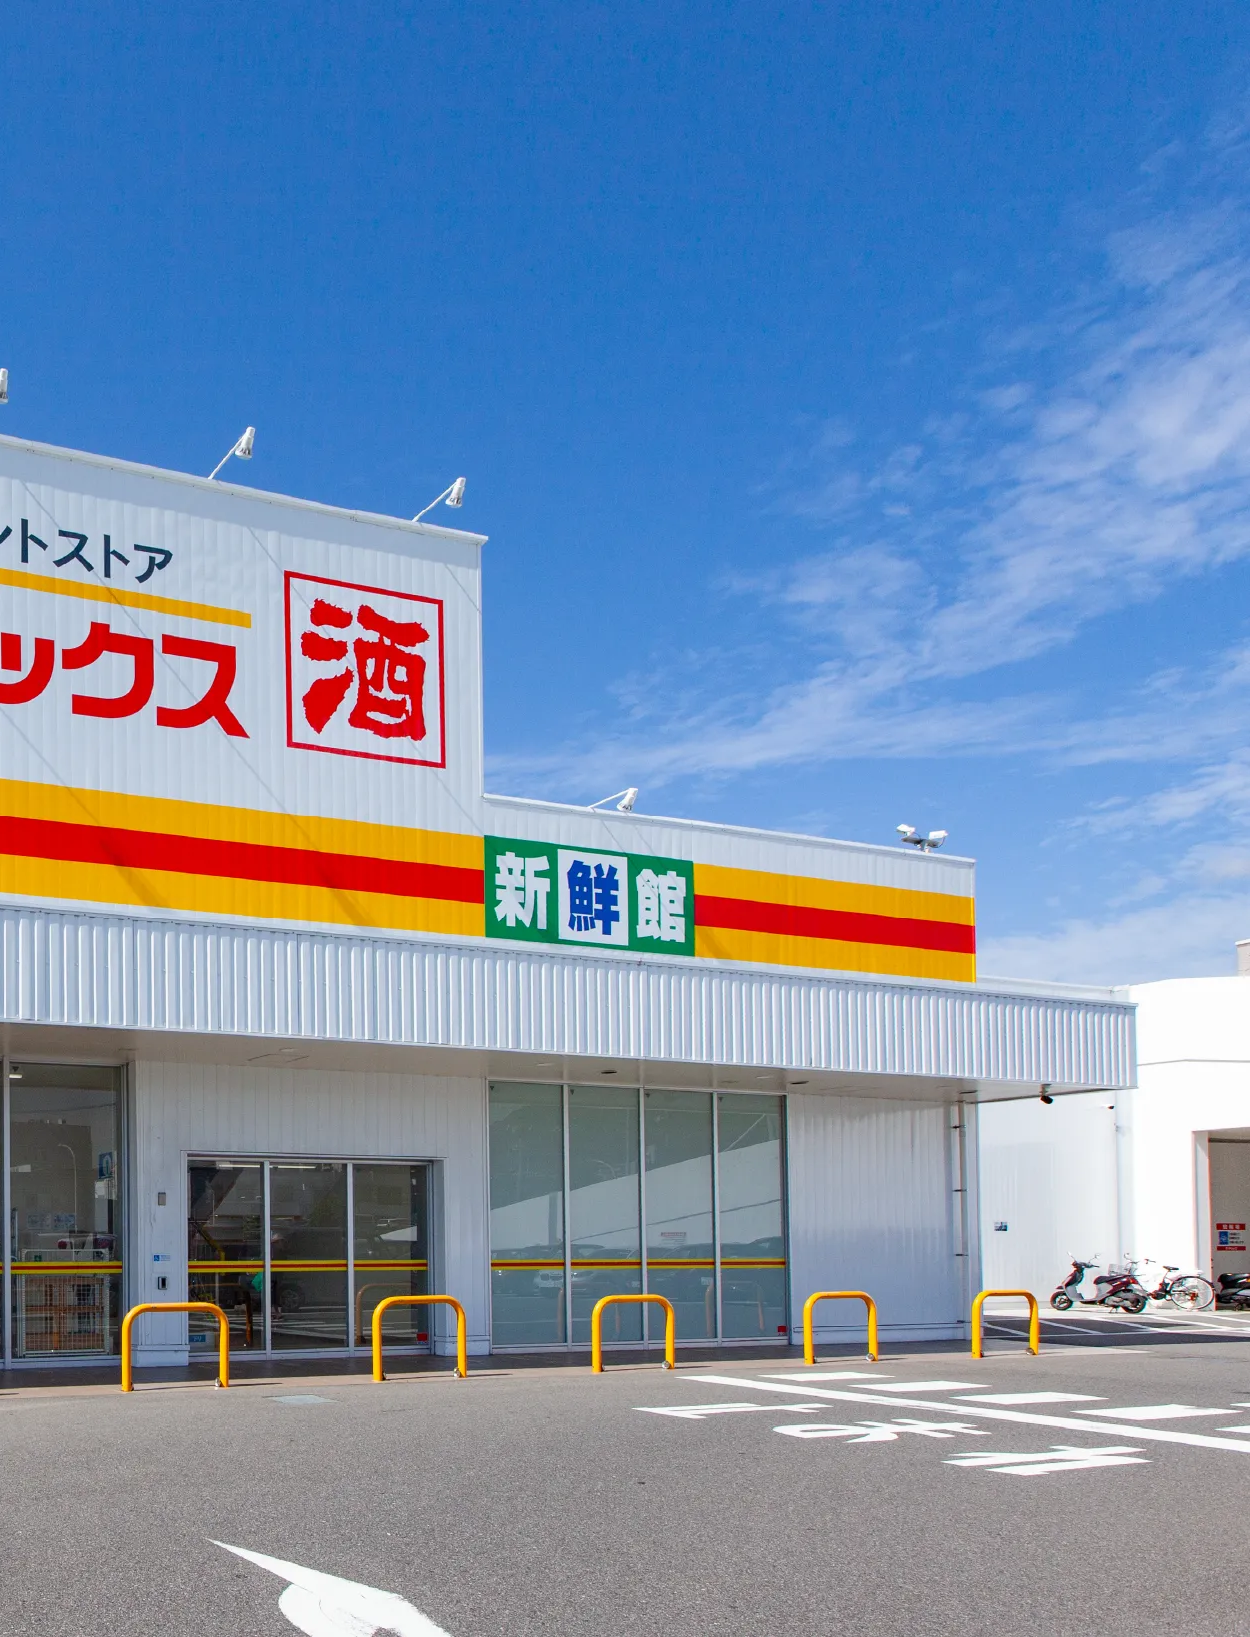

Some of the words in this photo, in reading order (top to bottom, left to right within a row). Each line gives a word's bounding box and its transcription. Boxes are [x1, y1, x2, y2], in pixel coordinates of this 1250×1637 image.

[300, 597, 430, 743] 酒
[494, 851, 687, 944] 新鮮館
